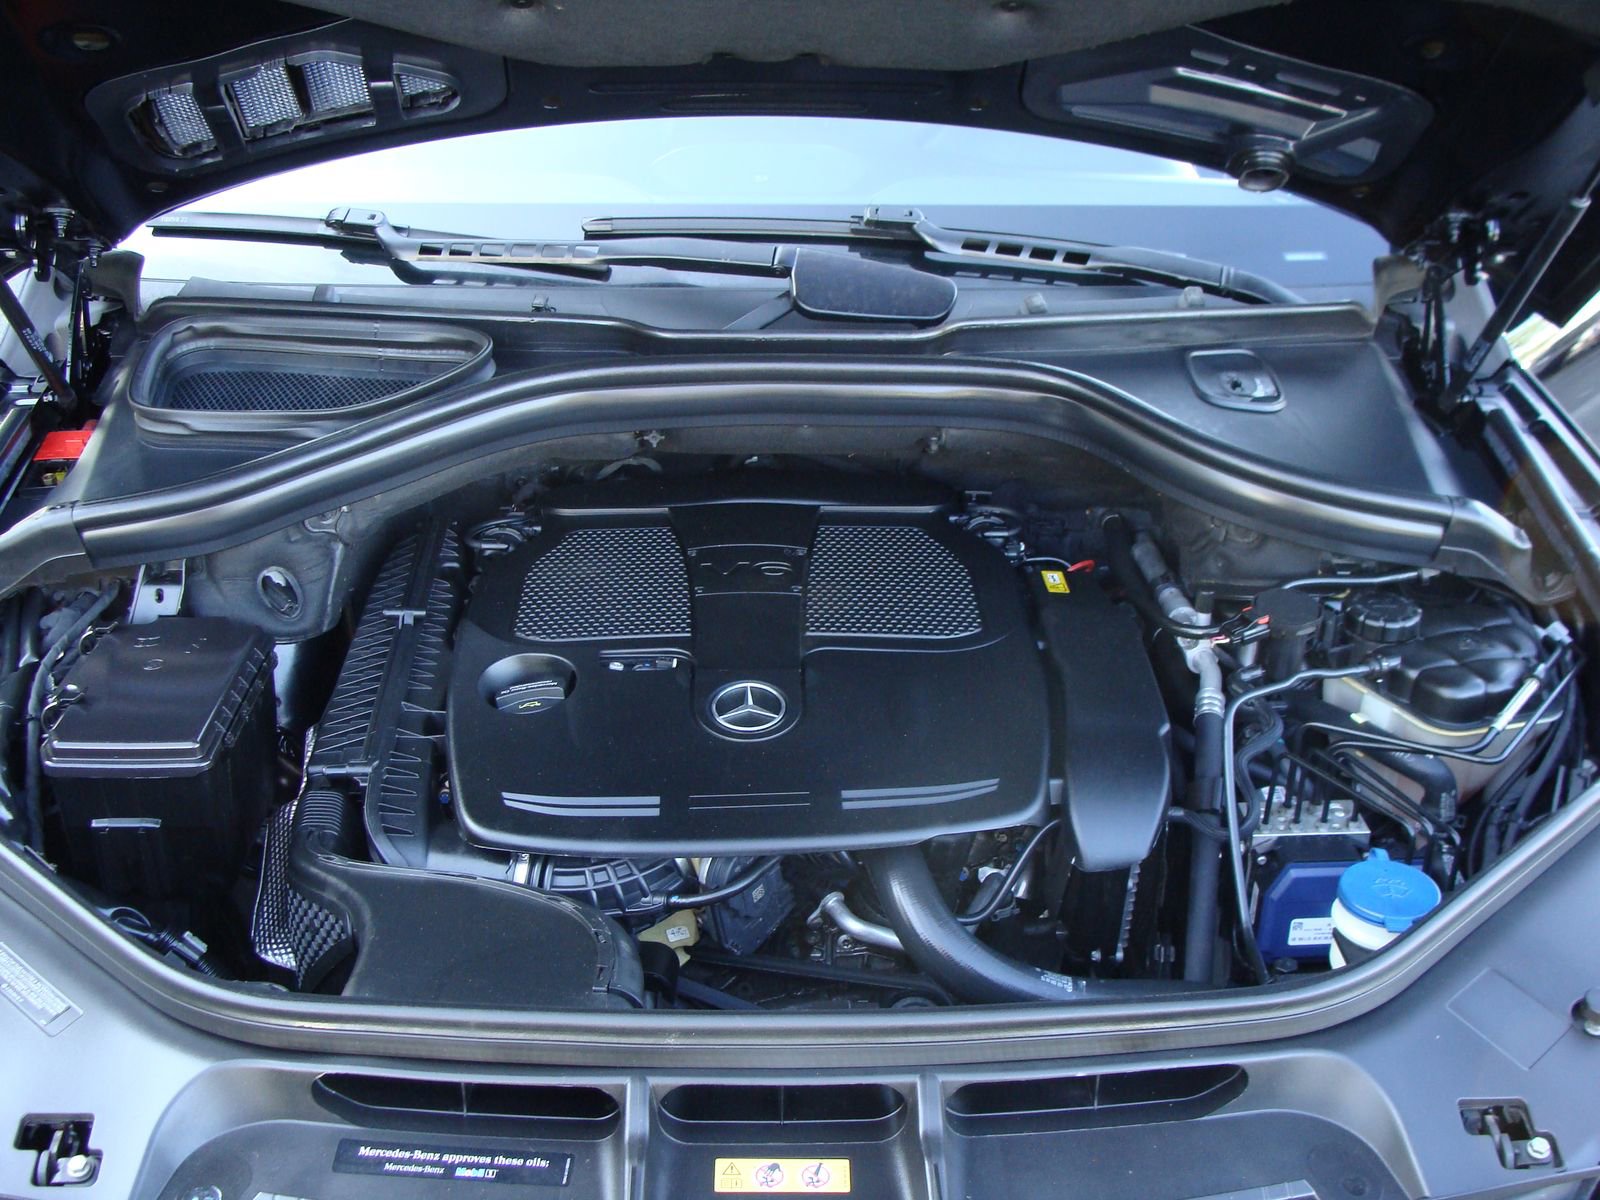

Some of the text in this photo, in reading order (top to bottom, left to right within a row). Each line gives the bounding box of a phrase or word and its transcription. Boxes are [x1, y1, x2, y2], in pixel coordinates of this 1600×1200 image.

[358, 1146, 440, 1160] Mercedes-Benz
[442, 1153, 492, 1164] approves
[493, 1155, 524, 1166] these
[384, 1162, 445, 1174] Mercedes-Benz
